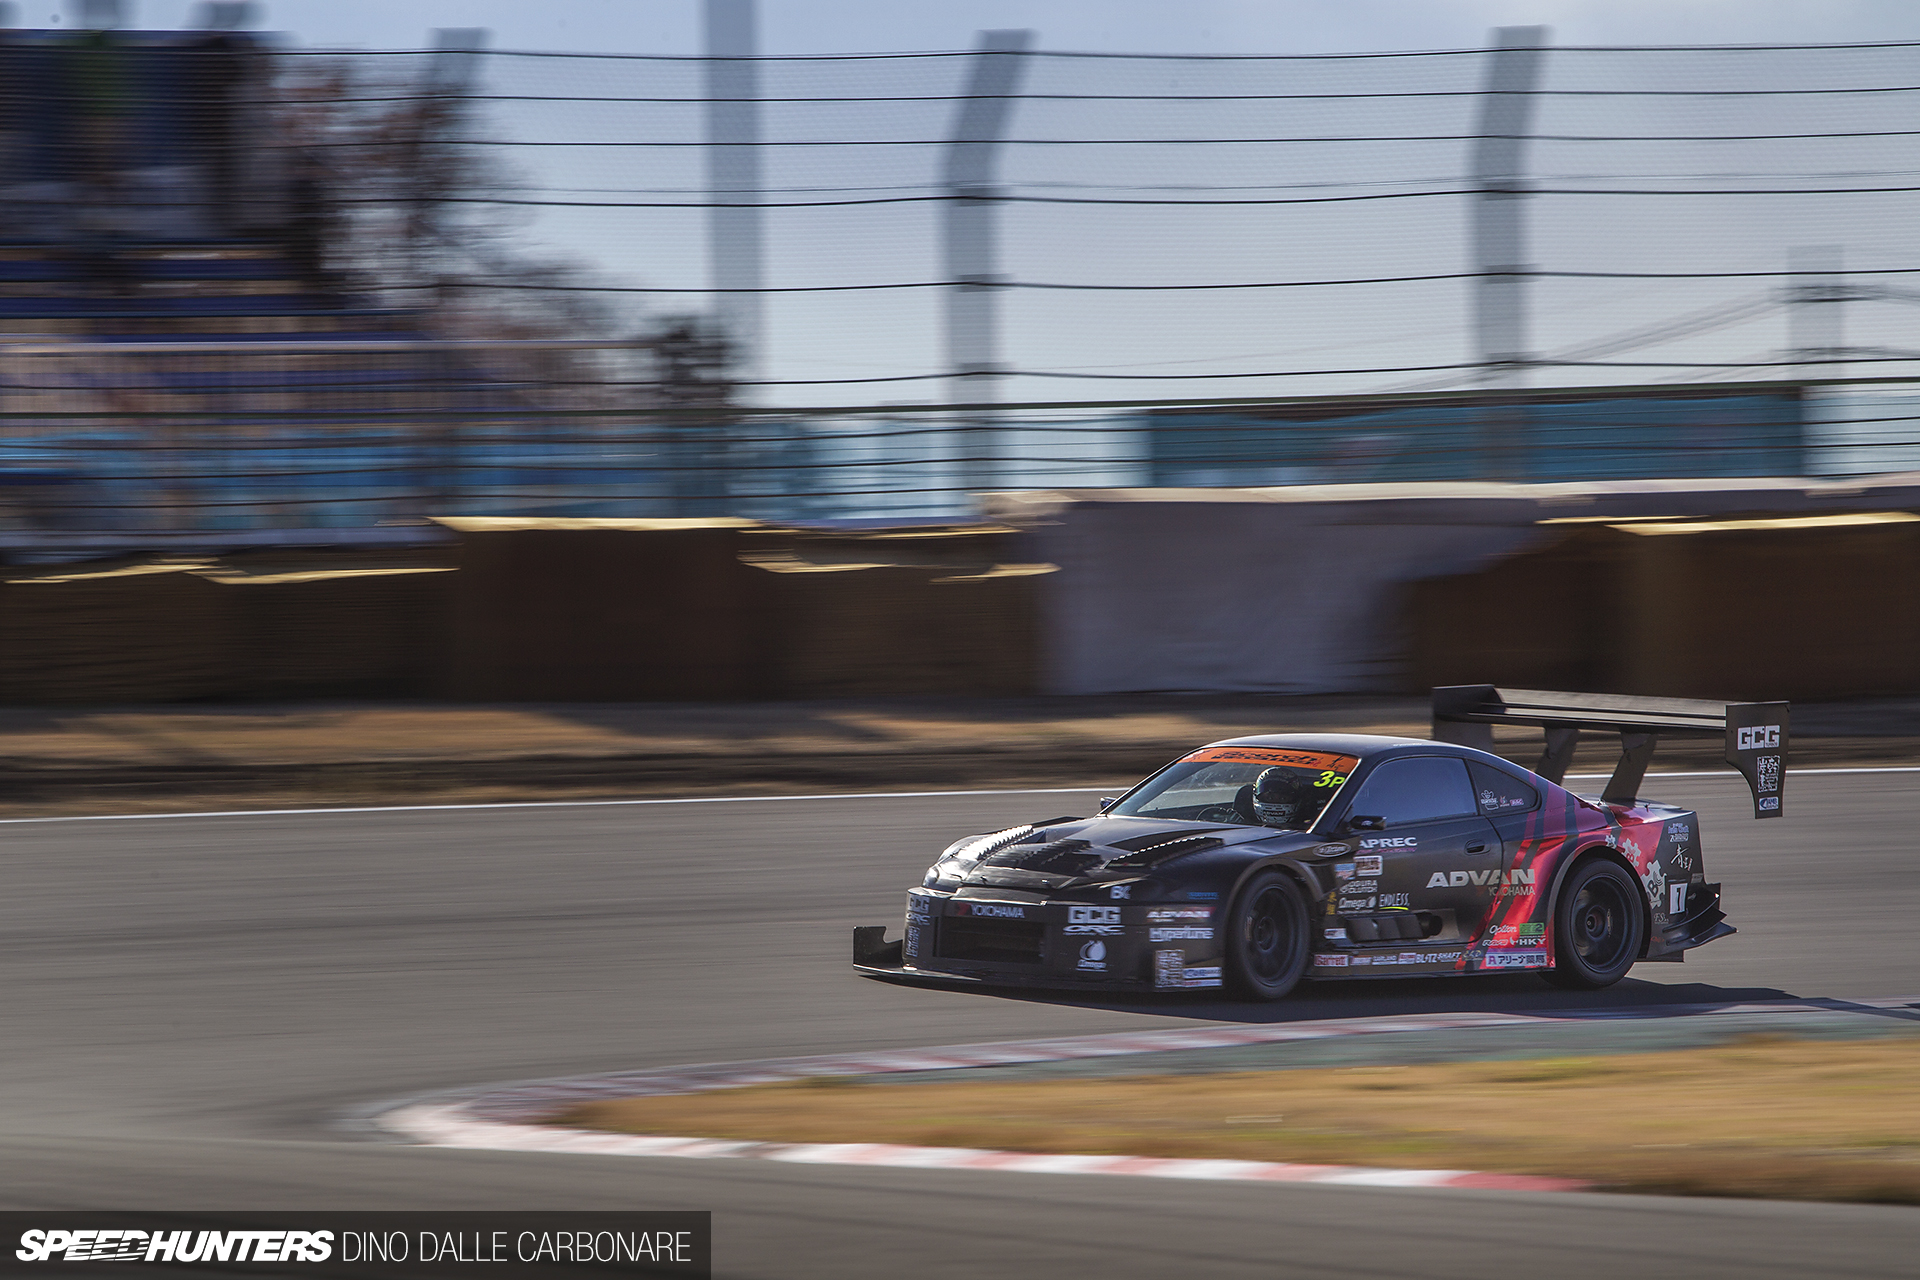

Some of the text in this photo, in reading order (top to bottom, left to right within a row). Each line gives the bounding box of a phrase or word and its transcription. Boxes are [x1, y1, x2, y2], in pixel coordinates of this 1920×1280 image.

[1738, 725, 1780, 750] GCG
[1426, 869, 1535, 888] ADVAN
[1676, 887, 1681, 912] 1
[971, 903, 1025, 918] YOKOHAMA
[1068, 907, 1121, 923] GCG
[1519, 938, 1546, 946] HKY
